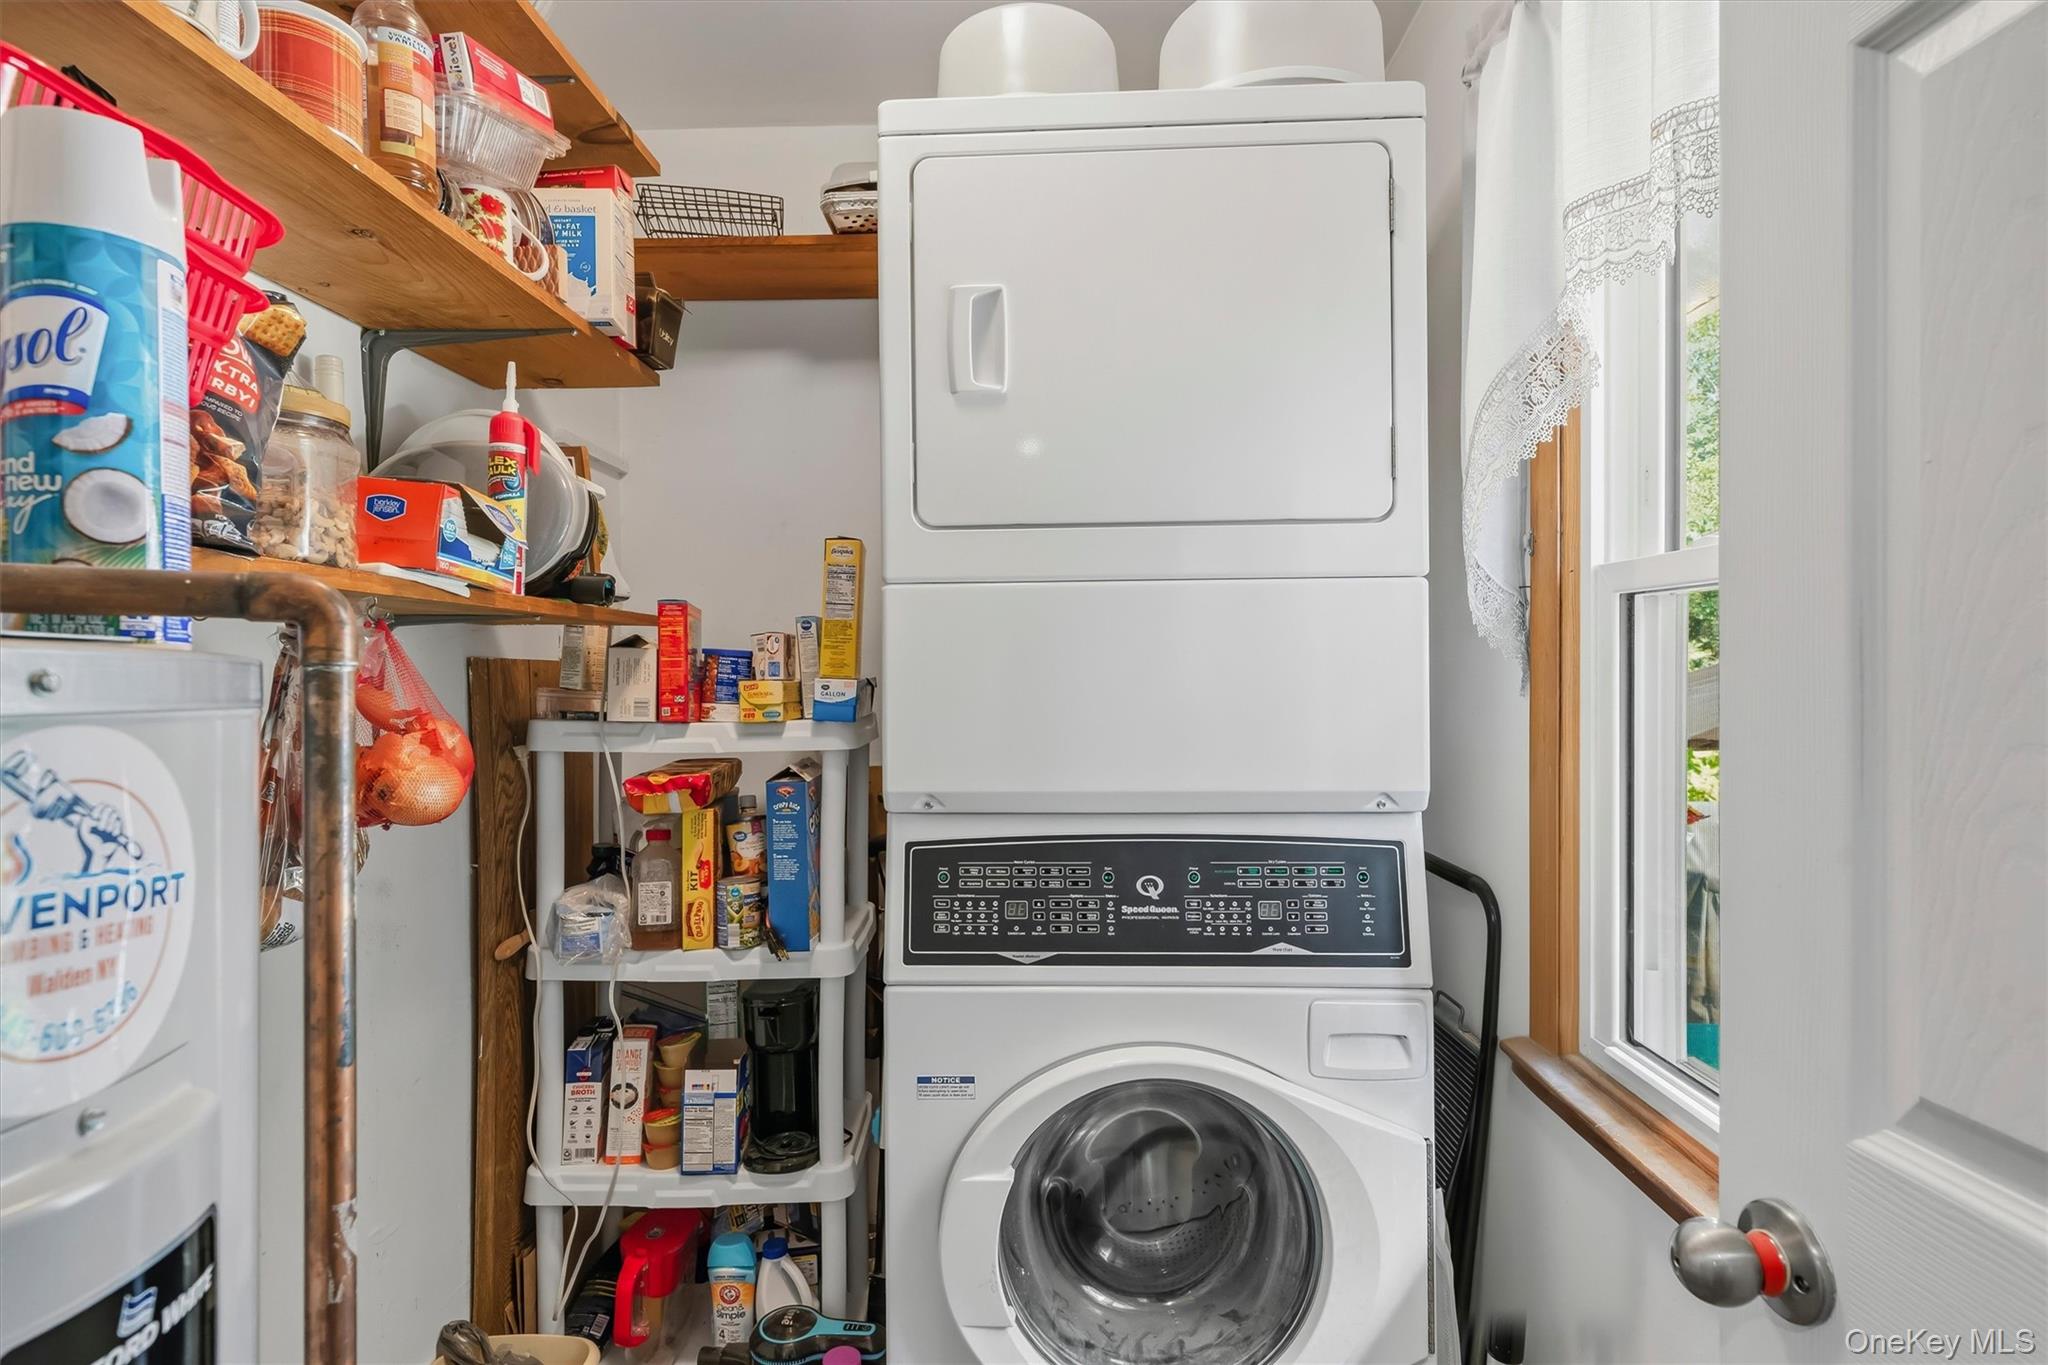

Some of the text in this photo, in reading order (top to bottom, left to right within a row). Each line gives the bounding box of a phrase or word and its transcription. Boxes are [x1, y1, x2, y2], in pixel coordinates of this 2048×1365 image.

[564, 204, 597, 213] basket
[5, 473, 62, 492] new
[690, 871, 698, 891] KIT
[1121, 905, 1149, 915] Speed
[570, 1089, 596, 1097] BROTH
[716, 1310, 746, 1320] Simple
